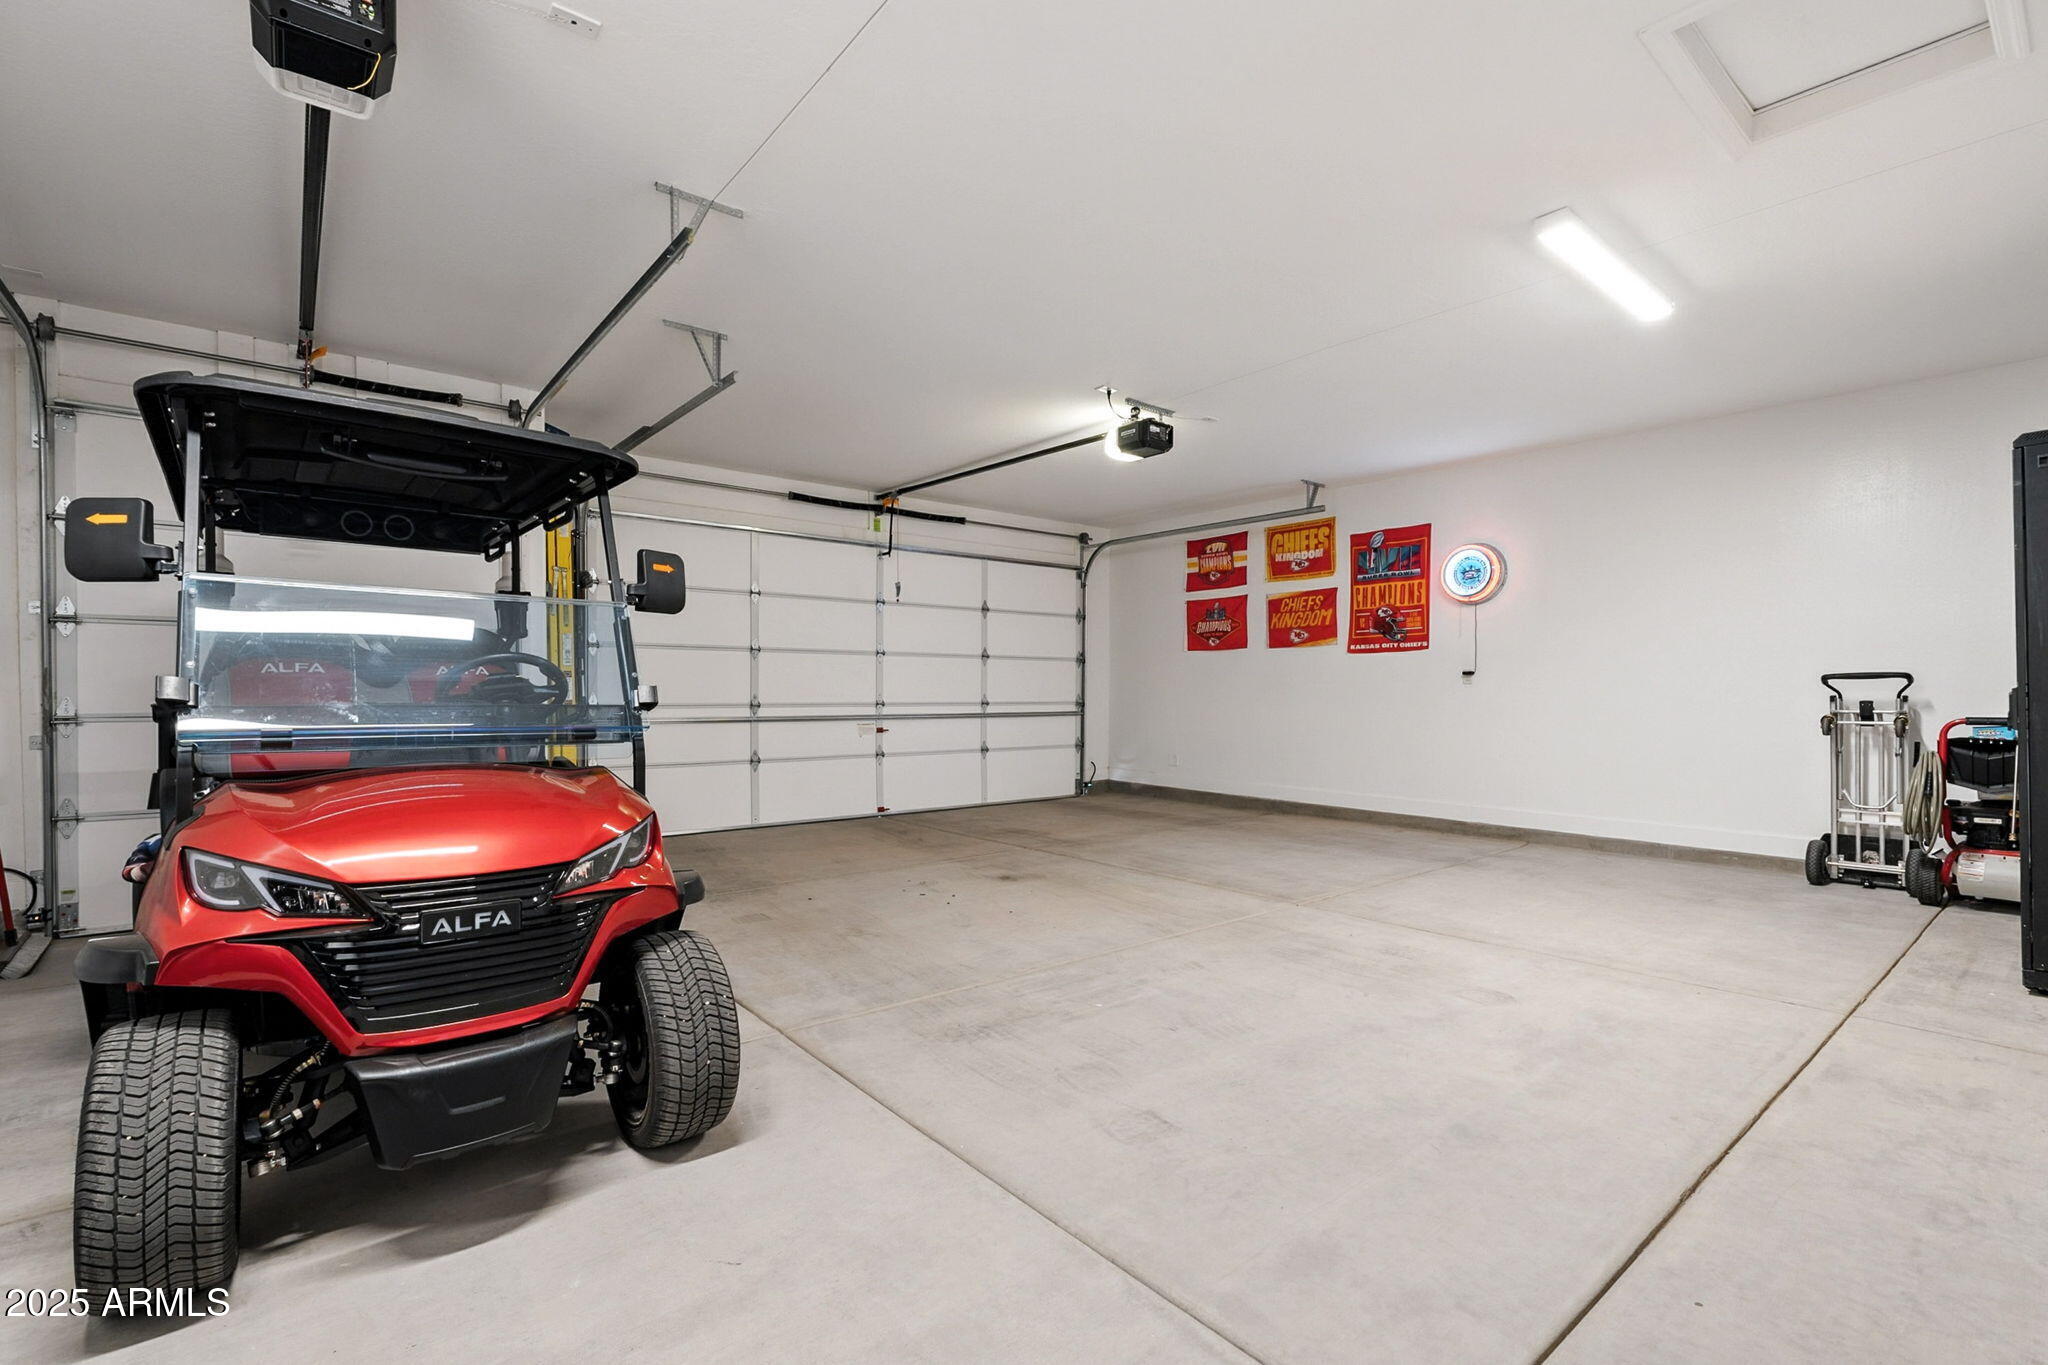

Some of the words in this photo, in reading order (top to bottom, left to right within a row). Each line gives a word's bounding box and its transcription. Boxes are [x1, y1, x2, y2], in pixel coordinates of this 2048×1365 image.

[1271, 526, 1330, 555] CHIEFS
[1275, 548, 1324, 562] KINGDOM
[1280, 595, 1324, 613] CHIEFS
[1355, 581, 1423, 608] CHAMPIONS
[1196, 619, 1232, 634] CHAMPIONS
[1270, 608, 1333, 629] KINGDOM
[261, 662, 325, 673] ALFA
[431, 909, 512, 936] ALFA
